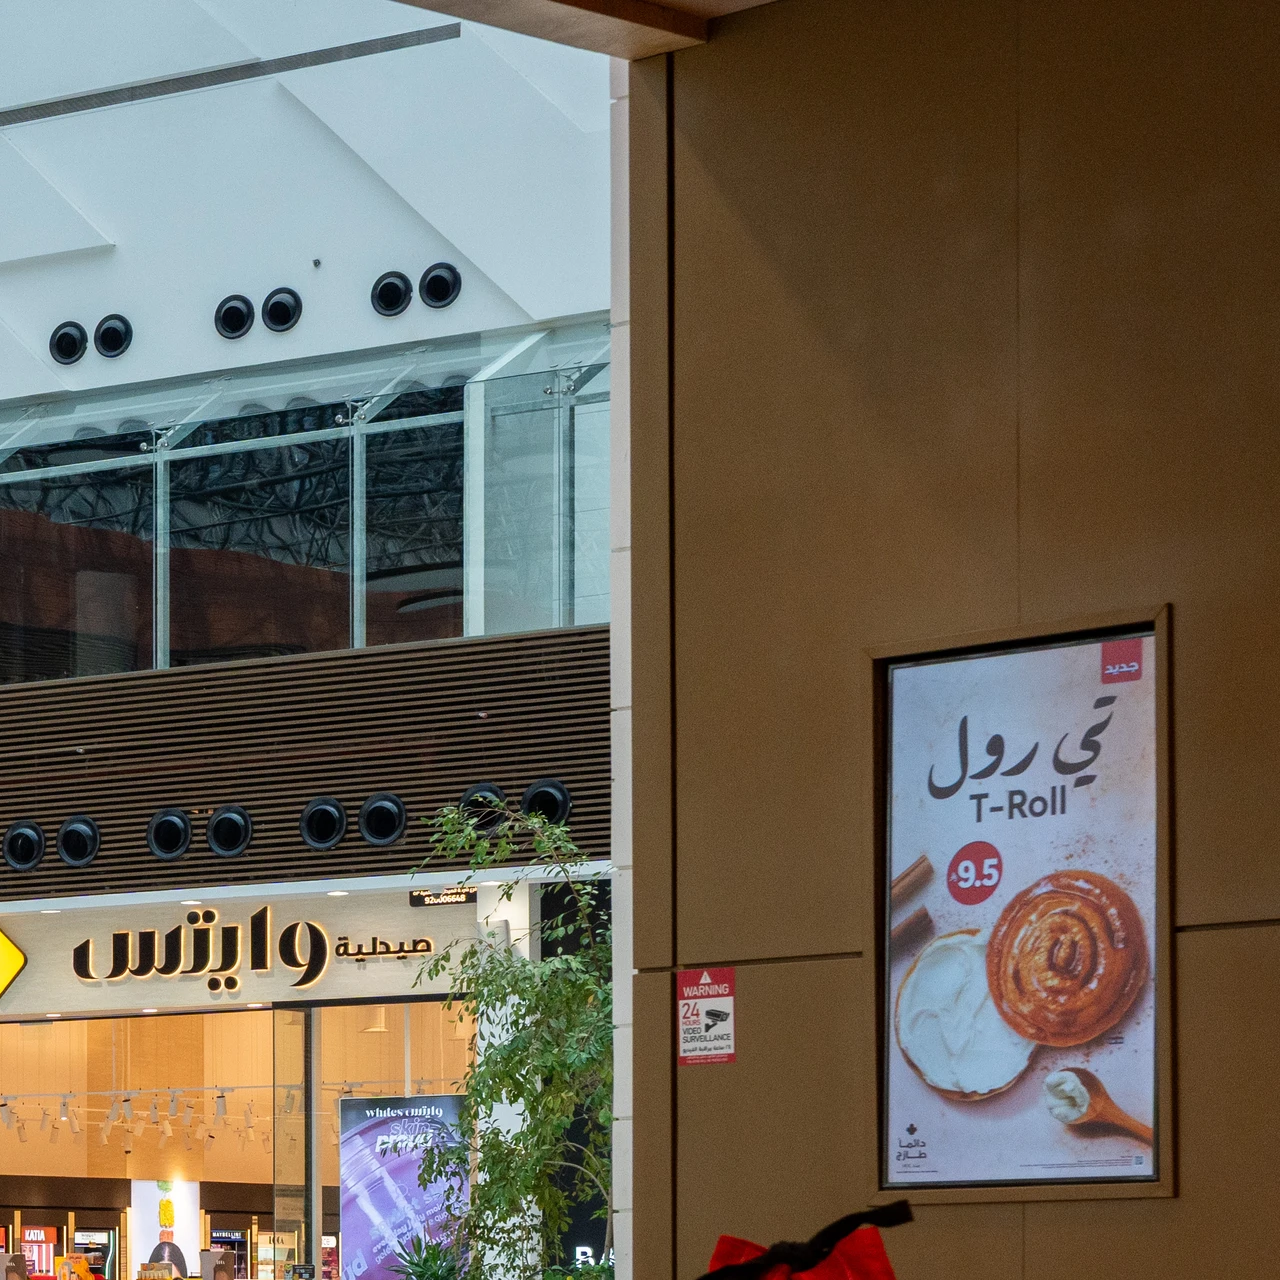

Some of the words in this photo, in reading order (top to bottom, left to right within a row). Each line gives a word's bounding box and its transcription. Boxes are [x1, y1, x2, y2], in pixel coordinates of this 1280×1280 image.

[1104, 660, 1139, 674] جديد
[928, 715, 1040, 799] رول
[969, 784, 1067, 823] T-Roll
[957, 857, 999, 888] 9.5
[73, 906, 328, 992] وايتس
[335, 936, 432, 962] صيدلية
[683, 984, 729, 997] WARNING
[682, 1002, 700, 1019] 24
[682, 1027, 702, 1035] VIDEO
[682, 1033, 731, 1043] SURVEILLANCE
[366, 1107, 403, 1117] whites
[405, 1106, 443, 1118] وايتس
[390, 1117, 430, 1136] skin
[24, 1229, 46, 1241] KATIA
